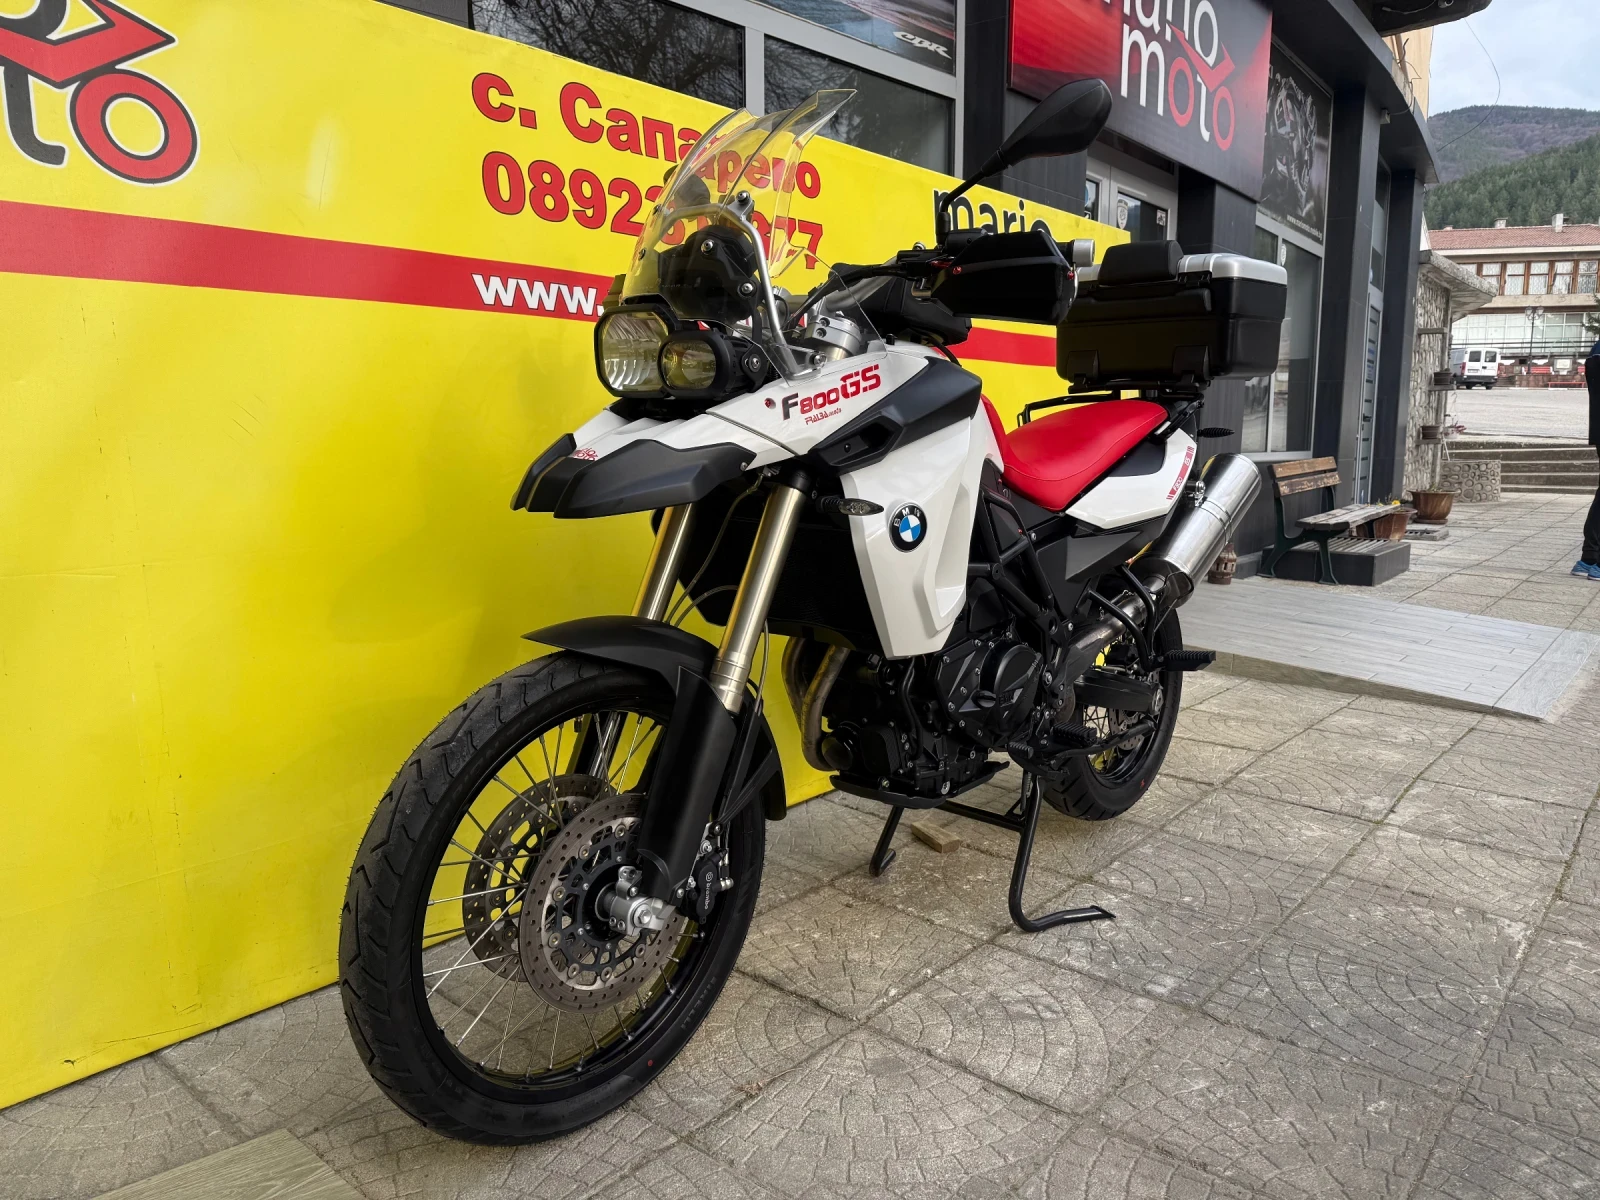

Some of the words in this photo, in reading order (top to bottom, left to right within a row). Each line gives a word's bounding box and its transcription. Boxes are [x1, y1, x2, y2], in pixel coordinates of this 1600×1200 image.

[1121, 23, 1235, 151] moto
[893, 507, 922, 528] BMW
[704, 882, 712, 910] brembo
